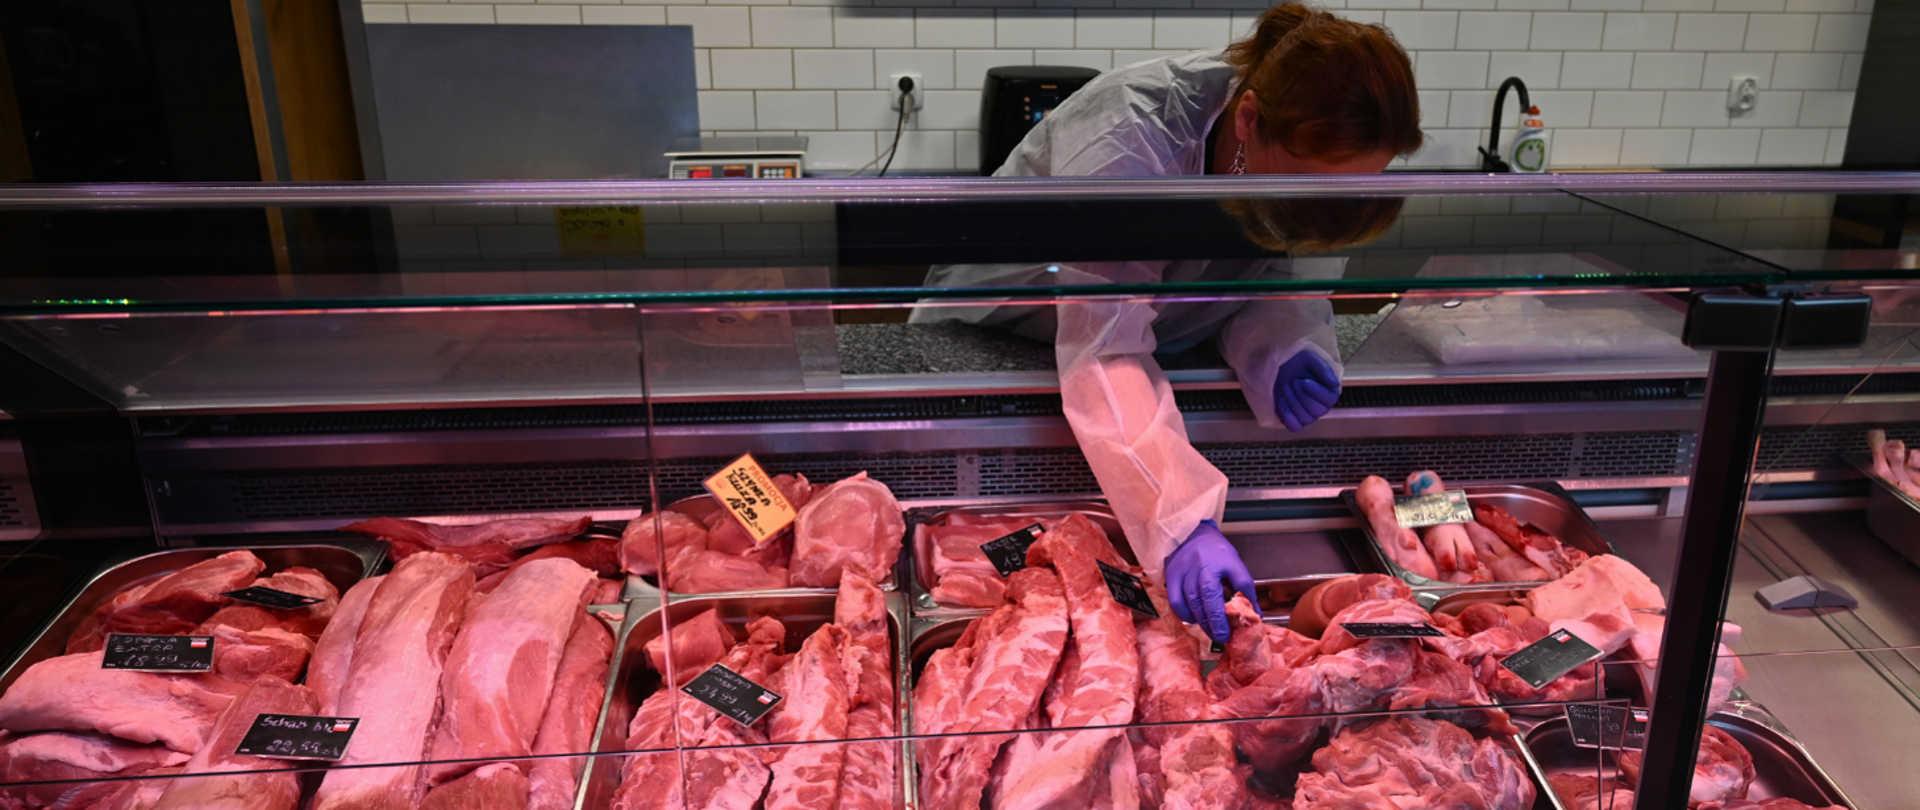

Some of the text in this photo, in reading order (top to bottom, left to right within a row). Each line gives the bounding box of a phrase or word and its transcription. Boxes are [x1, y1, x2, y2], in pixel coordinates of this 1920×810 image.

[748, 465, 788, 511] PROMOCJA
[115, 644, 173, 653] EXTRA
[260, 716, 307, 729] Schab
